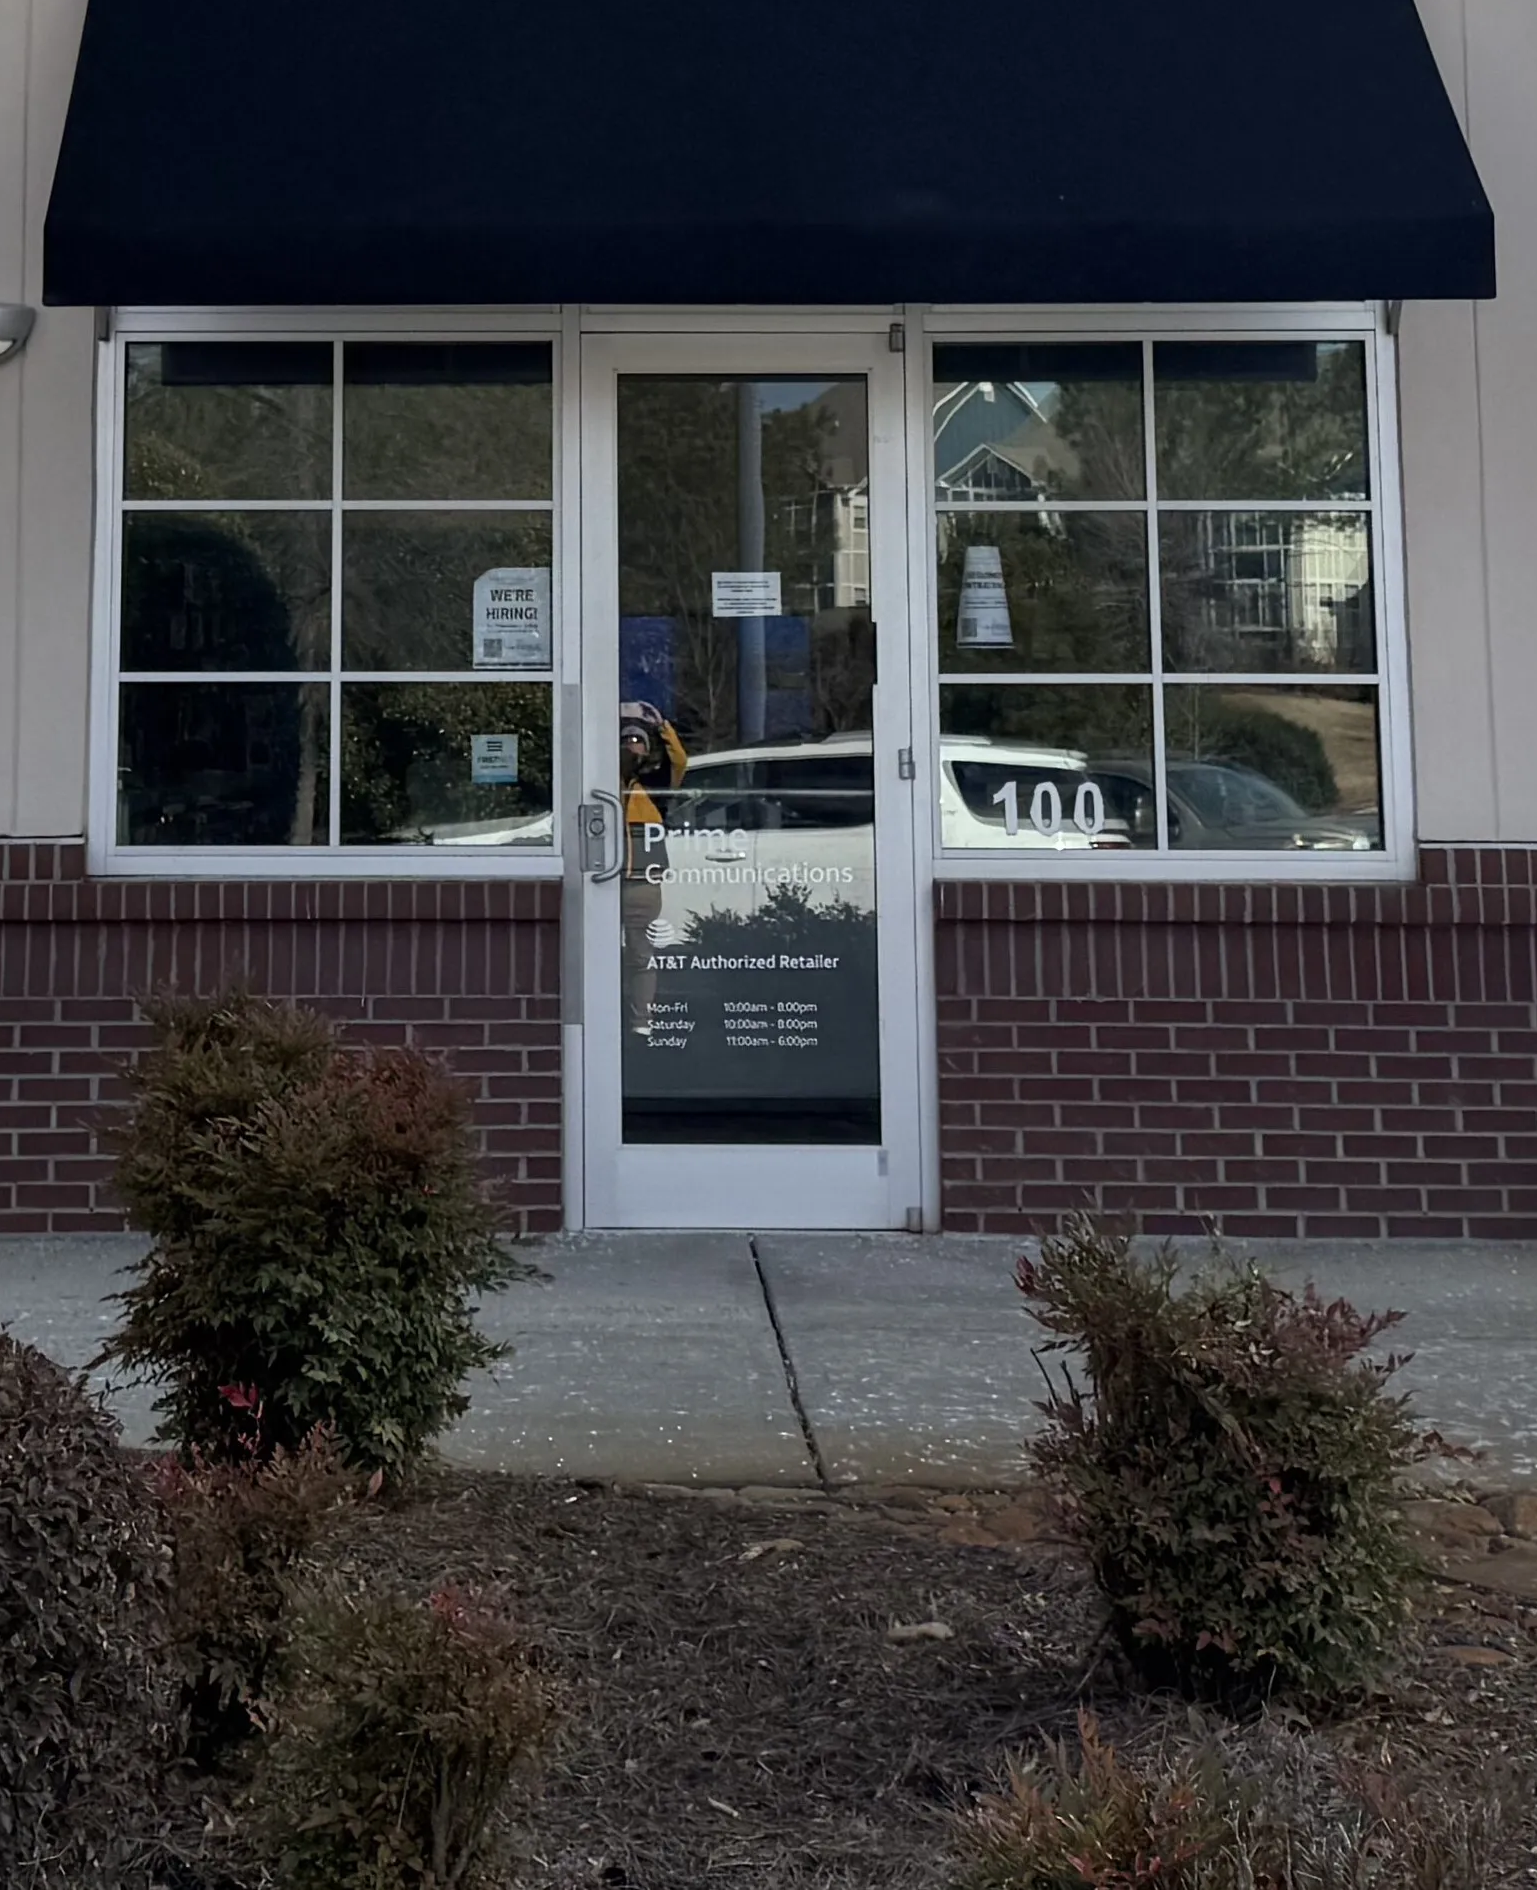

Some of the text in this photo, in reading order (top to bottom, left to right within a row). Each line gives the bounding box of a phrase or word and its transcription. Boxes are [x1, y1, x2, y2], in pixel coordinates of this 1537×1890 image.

[992, 780, 1106, 837] 100
[644, 821, 749, 853] Prime
[644, 861, 855, 885] Communications
[646, 954, 840, 970] AT&T Authorized Retailer
